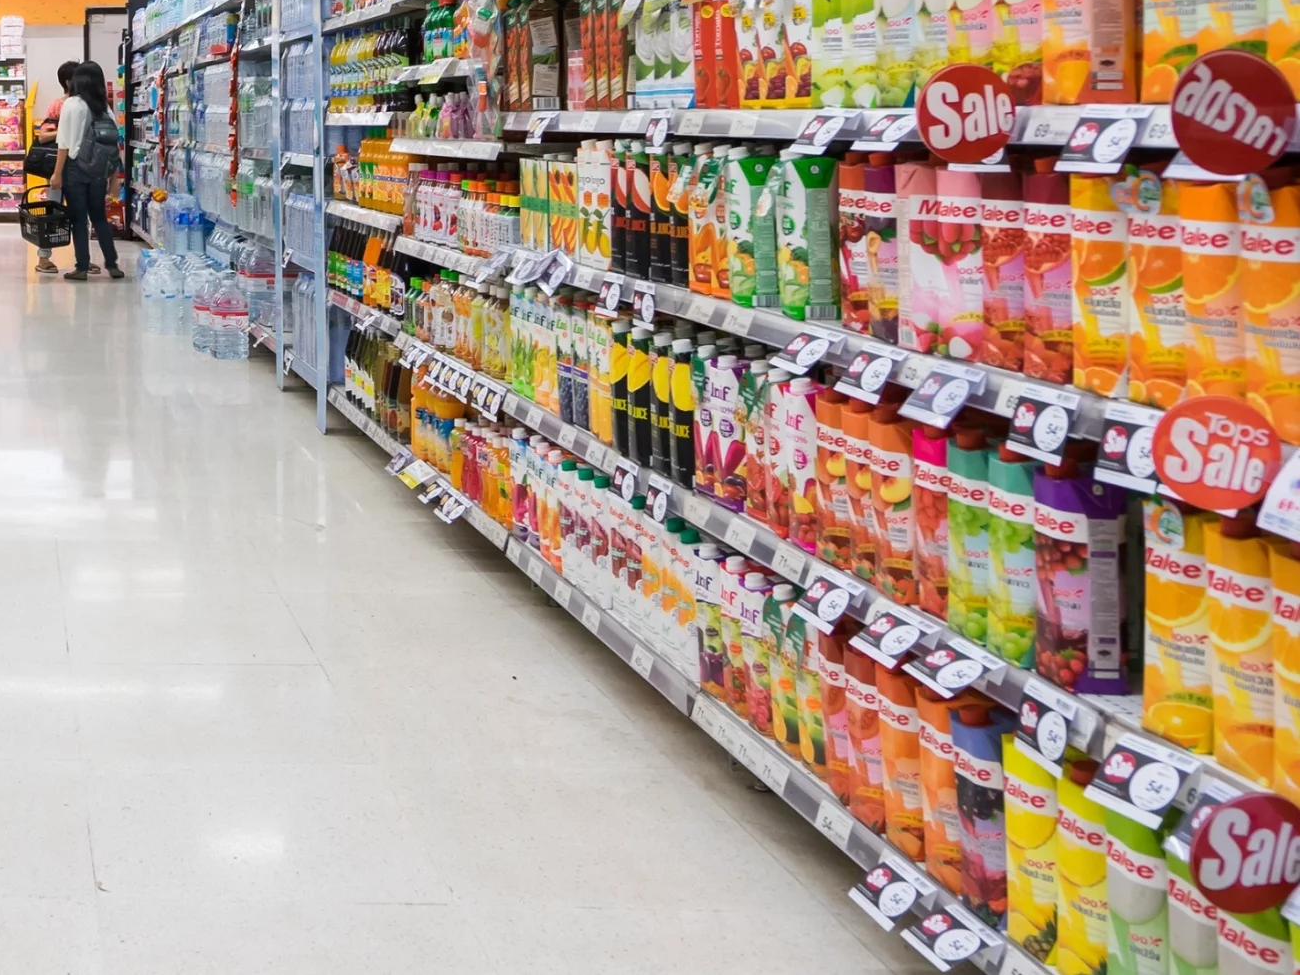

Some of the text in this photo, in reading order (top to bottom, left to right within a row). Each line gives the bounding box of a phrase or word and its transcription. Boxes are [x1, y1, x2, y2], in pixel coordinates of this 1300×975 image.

[925, 81, 1016, 151] Sale
[1173, 61, 1288, 157] ลดราคา
[1164, 416, 1267, 495] Sale
[1203, 411, 1270, 448] Tops
[1200, 807, 1300, 891] Sale
